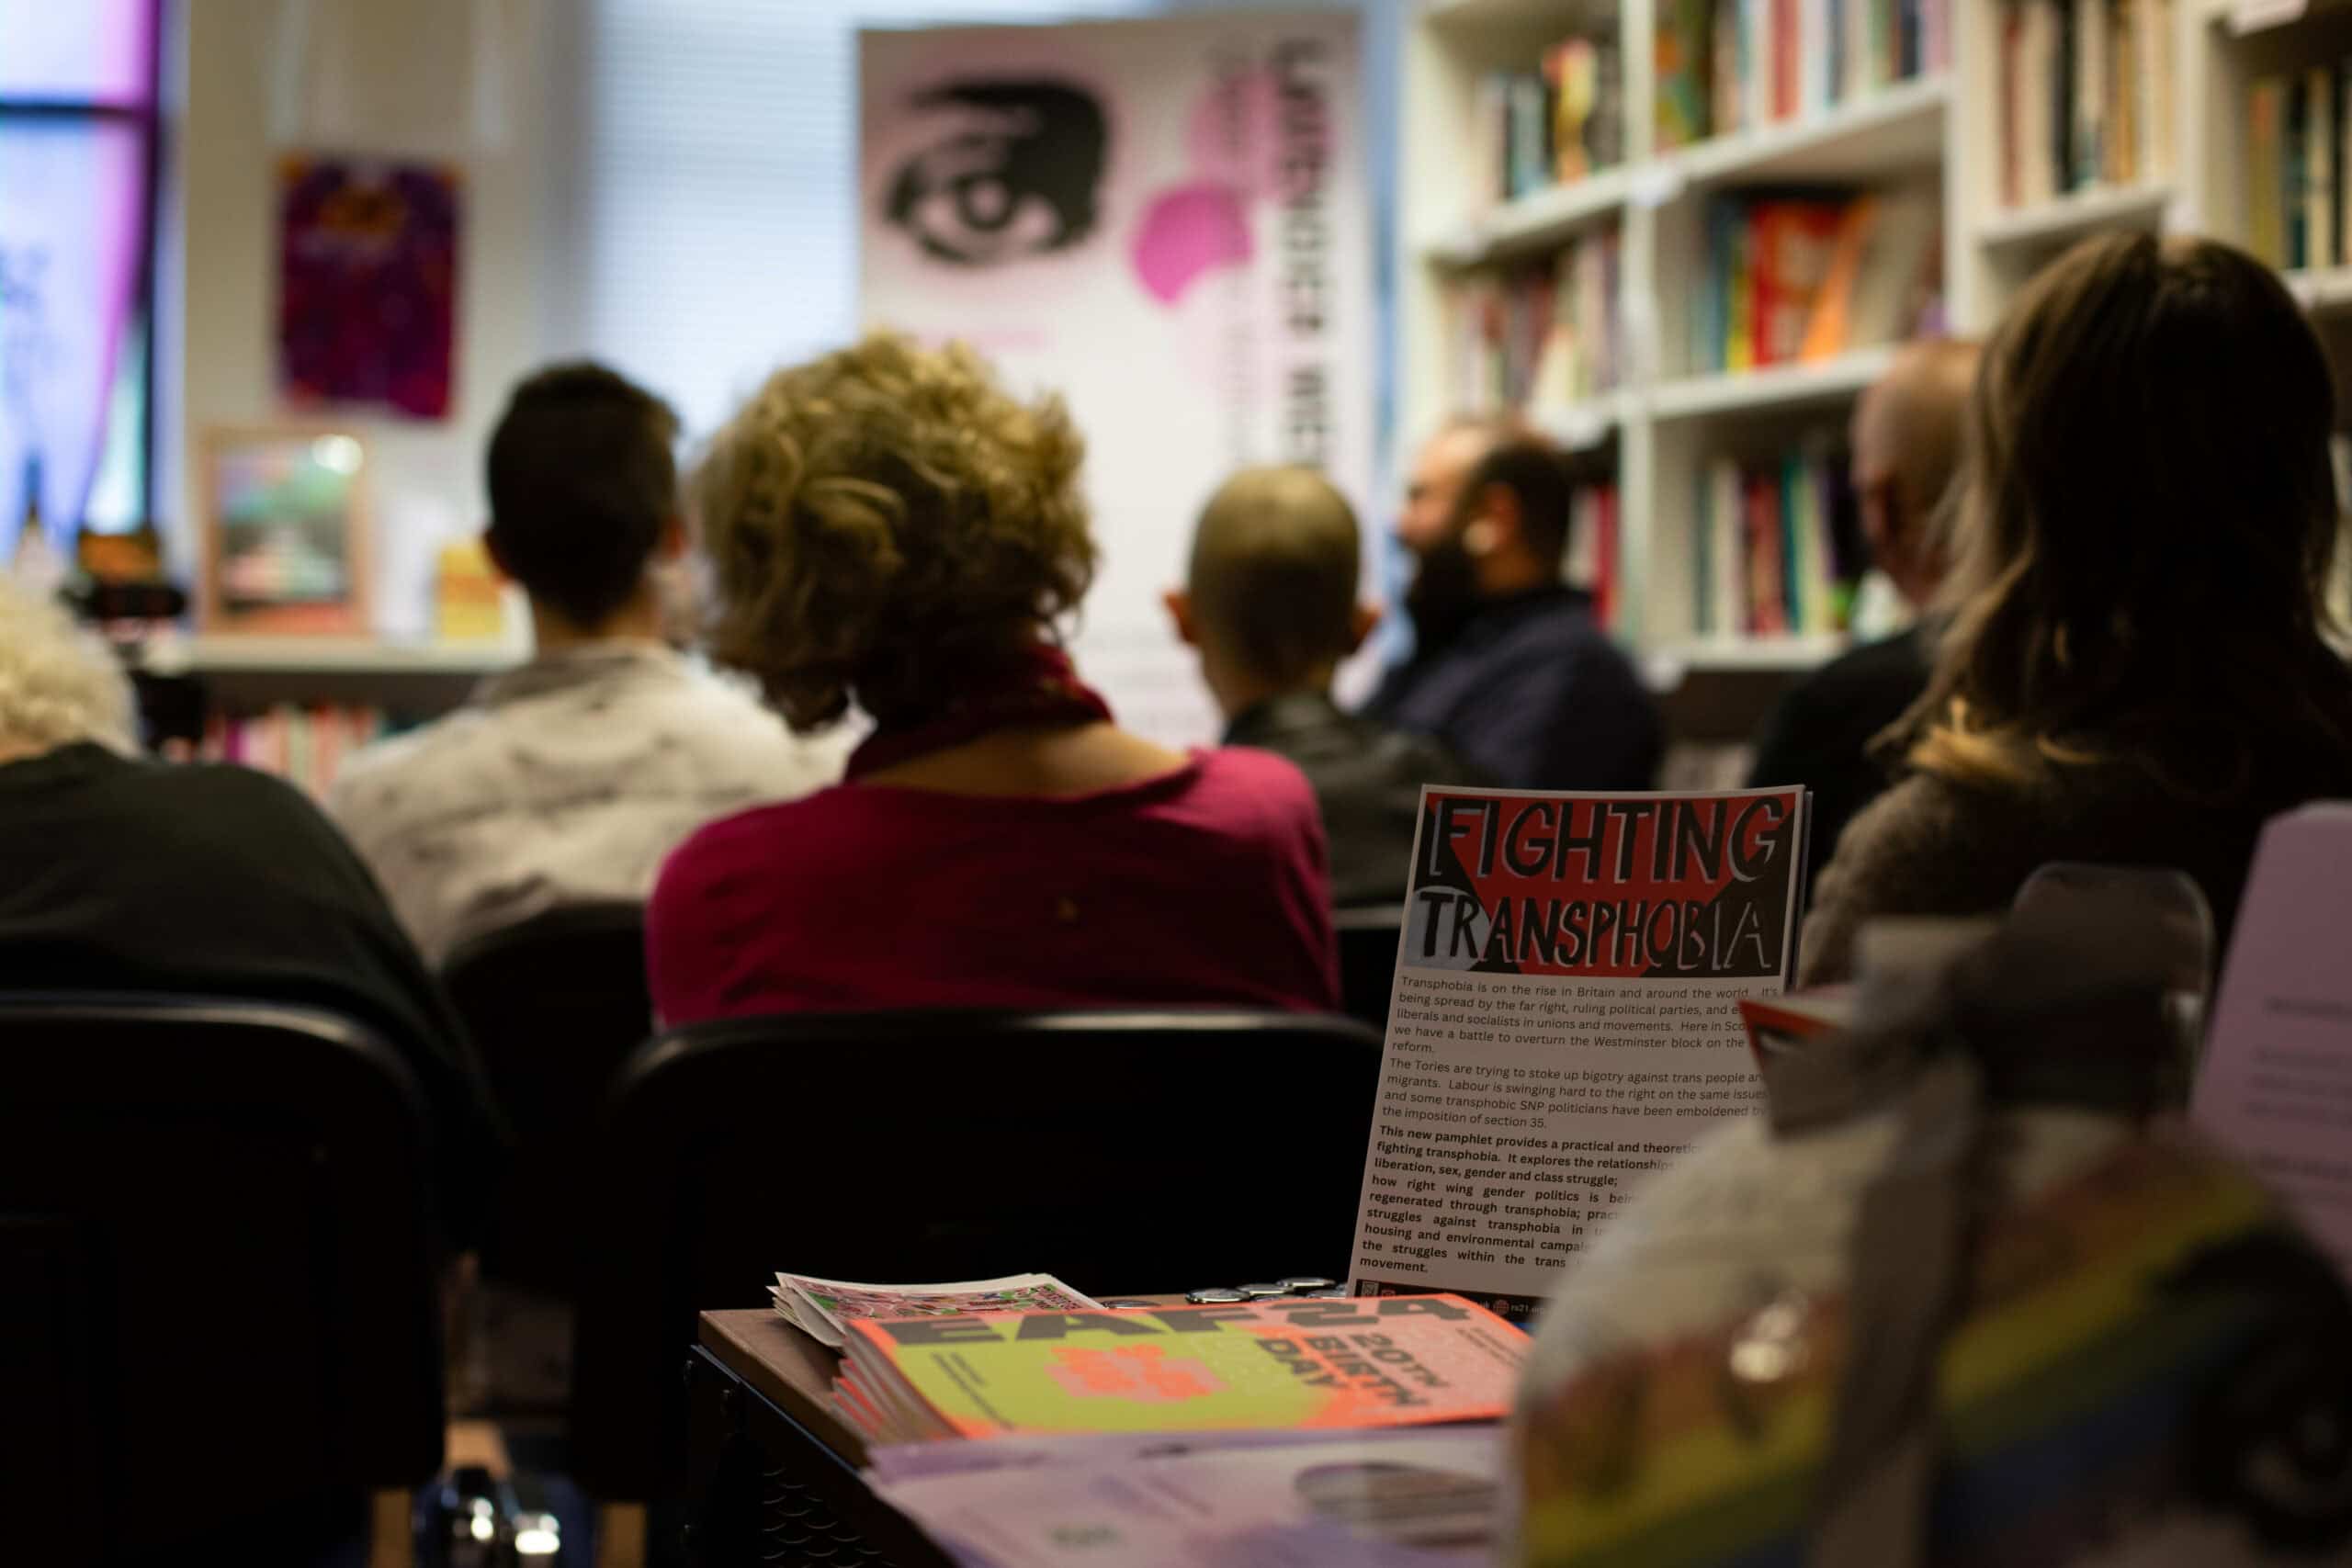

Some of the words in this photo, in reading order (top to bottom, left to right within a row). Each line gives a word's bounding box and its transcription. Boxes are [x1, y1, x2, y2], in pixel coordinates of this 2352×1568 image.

[1428, 795, 1785, 884] FIGHTING
[1418, 891, 1772, 971] TRANSPHOBIA
[1401, 976, 1473, 992] Transphobia
[1477, 982, 1487, 992] is
[1491, 985, 1507, 993] on
[1511, 984, 1531, 995] the
[1535, 985, 1556, 996] rise
[1561, 986, 1572, 996] in
[1577, 987, 1615, 998] Britain
[1619, 987, 1641, 998] and
[1646, 988, 1687, 998] around
[1691, 988, 1712, 998] the
[1398, 993, 1430, 1007] being
[1433, 997, 1475, 1007] spread
[1477, 998, 1492, 1011] by
[1496, 999, 1515, 1010] the
[1519, 1000, 1536, 1010] far
[1539, 1002, 1568, 1014] right,
[1572, 1003, 1605, 1016] ruling
[1609, 1004, 1655, 1016] political
[1658, 1004, 1702, 1017] parties,
[1705, 1004, 1727, 1014] and
[1396, 1009, 1439, 1021] liberals
[1442, 1013, 1464, 1022] and
[1466, 1015, 1520, 1027] socialists
[1522, 1017, 1533, 1027] in
[1536, 1018, 1575, 1029] unions
[1578, 1020, 1600, 1030] and
[1602, 1021, 1674, 1032] movements.
[1680, 1021, 1708, 1032] Here
[1711, 1021, 1721, 1031] in
[1724, 1020, 1747, 1031] Sco
[1392, 1041, 1435, 1054] reform.
[1394, 1027, 1410, 1035] we
[1415, 1026, 1442, 1038] have
[1447, 1031, 1453, 1039] a
[1459, 1030, 1494, 1041] battle
[1498, 1032, 1510, 1043] to
[1514, 1035, 1565, 1043] overturn
[1569, 1035, 1589, 1046] the
[1594, 1036, 1667, 1047] Westminster
[1670, 1037, 1702, 1047] block
[1706, 1039, 1720, 1047] on
[1725, 1037, 1745, 1047] the
[1390, 1057, 1411, 1070] The
[1416, 1060, 1450, 1073] Tories
[1453, 1065, 1472, 1074] are
[1476, 1066, 1510, 1077] trying
[1513, 1067, 1525, 1077] to
[1528, 1070, 1560, 1081] stoke
[1564, 1072, 1578, 1081] up
[1581, 1070, 1624, 1085] bigotry
[1627, 1072, 1668, 1084] against
[1672, 1072, 1702, 1083] trans
[1705, 1072, 1745, 1085] people
[1747, 1074, 1764, 1082] an
[1386, 1075, 1442, 1089] migrants.
[1448, 1079, 1490, 1091] Labour
[1492, 1082, 1502, 1092] is
[1505, 1084, 1555, 1098] swinging
[1558, 1086, 1586, 1097] hard
[1589, 1088, 1601, 1097] to
[1605, 1088, 1624, 1098] the
[1628, 1088, 1656, 1100] right
[1658, 1090, 1673, 1099] on
[1677, 1089, 1696, 1100] the
[1699, 1091, 1729, 1100] same
[1382, 1106, 1401, 1117] the
[1404, 1108, 1466, 1124] imposition
[1469, 1113, 1482, 1123] of
[1484, 1116, 1527, 1126] section
[1529, 1117, 1546, 1127] 35.
[1384, 1090, 1407, 1100] and
[1409, 1094, 1442, 1105] some
[1445, 1096, 1516, 1110] transphobic
[1520, 1100, 1544, 1111] SNP
[1548, 1102, 1609, 1114] politicians
[1611, 1104, 1639, 1117] have
[1643, 1105, 1672, 1116] been
[1676, 1106, 1748, 1117] emboldened
[1379, 1125, 1404, 1138] This
[1407, 1131, 1431, 1139] new
[1434, 1132, 1492, 1145] pamphlet
[1495, 1136, 1548, 1148] provides
[1561, 1141, 1613, 1154] practical
[1617, 1143, 1639, 1153] and
[1643, 1143, 1705, 1155] theoretic
[1376, 1141, 1423, 1158] fighting
[1426, 1147, 1501, 1162] transphobia.
[1508, 1153, 1517, 1163] It
[1520, 1154, 1571, 1168] explores
[1574, 1156, 1593, 1168] the
[1374, 1158, 1436, 1176] liberation,
[1438, 1167, 1461, 1178] sex,
[1464, 1168, 1506, 1179] gender
[1509, 1171, 1531, 1180] and
[1533, 1172, 1564, 1182] class
[1566, 1174, 1617, 1188] struggle;
[1372, 1175, 1396, 1187] how
[1407, 1179, 1435, 1192] right
[1445, 1183, 1473, 1197] wing
[1482, 1187, 1525, 1199] gender
[1534, 1190, 1579, 1204] politics
[1589, 1192, 1599, 1202] is
[1369, 1192, 1442, 1208] regenerated
[1450, 1200, 1497, 1214] through
[1504, 1204, 1580, 1220] transphobia;
[1366, 1208, 1421, 1224] struggles
[1432, 1215, 1476, 1227] against
[1487, 1219, 1560, 1235] transphobia
[1571, 1224, 1582, 1235] in
[1364, 1223, 1411, 1240] housing
[1418, 1229, 1441, 1241] and
[1446, 1234, 1534, 1249] environmental
[1360, 1256, 1429, 1273] movement.
[1362, 1239, 1382, 1251] the
[1392, 1244, 1447, 1258] struggles
[1457, 1250, 1494, 1262] within
[1504, 1254, 1524, 1264] the
[1534, 1256, 1566, 1268] trans
[1254, 1337, 1349, 1388] DAY
